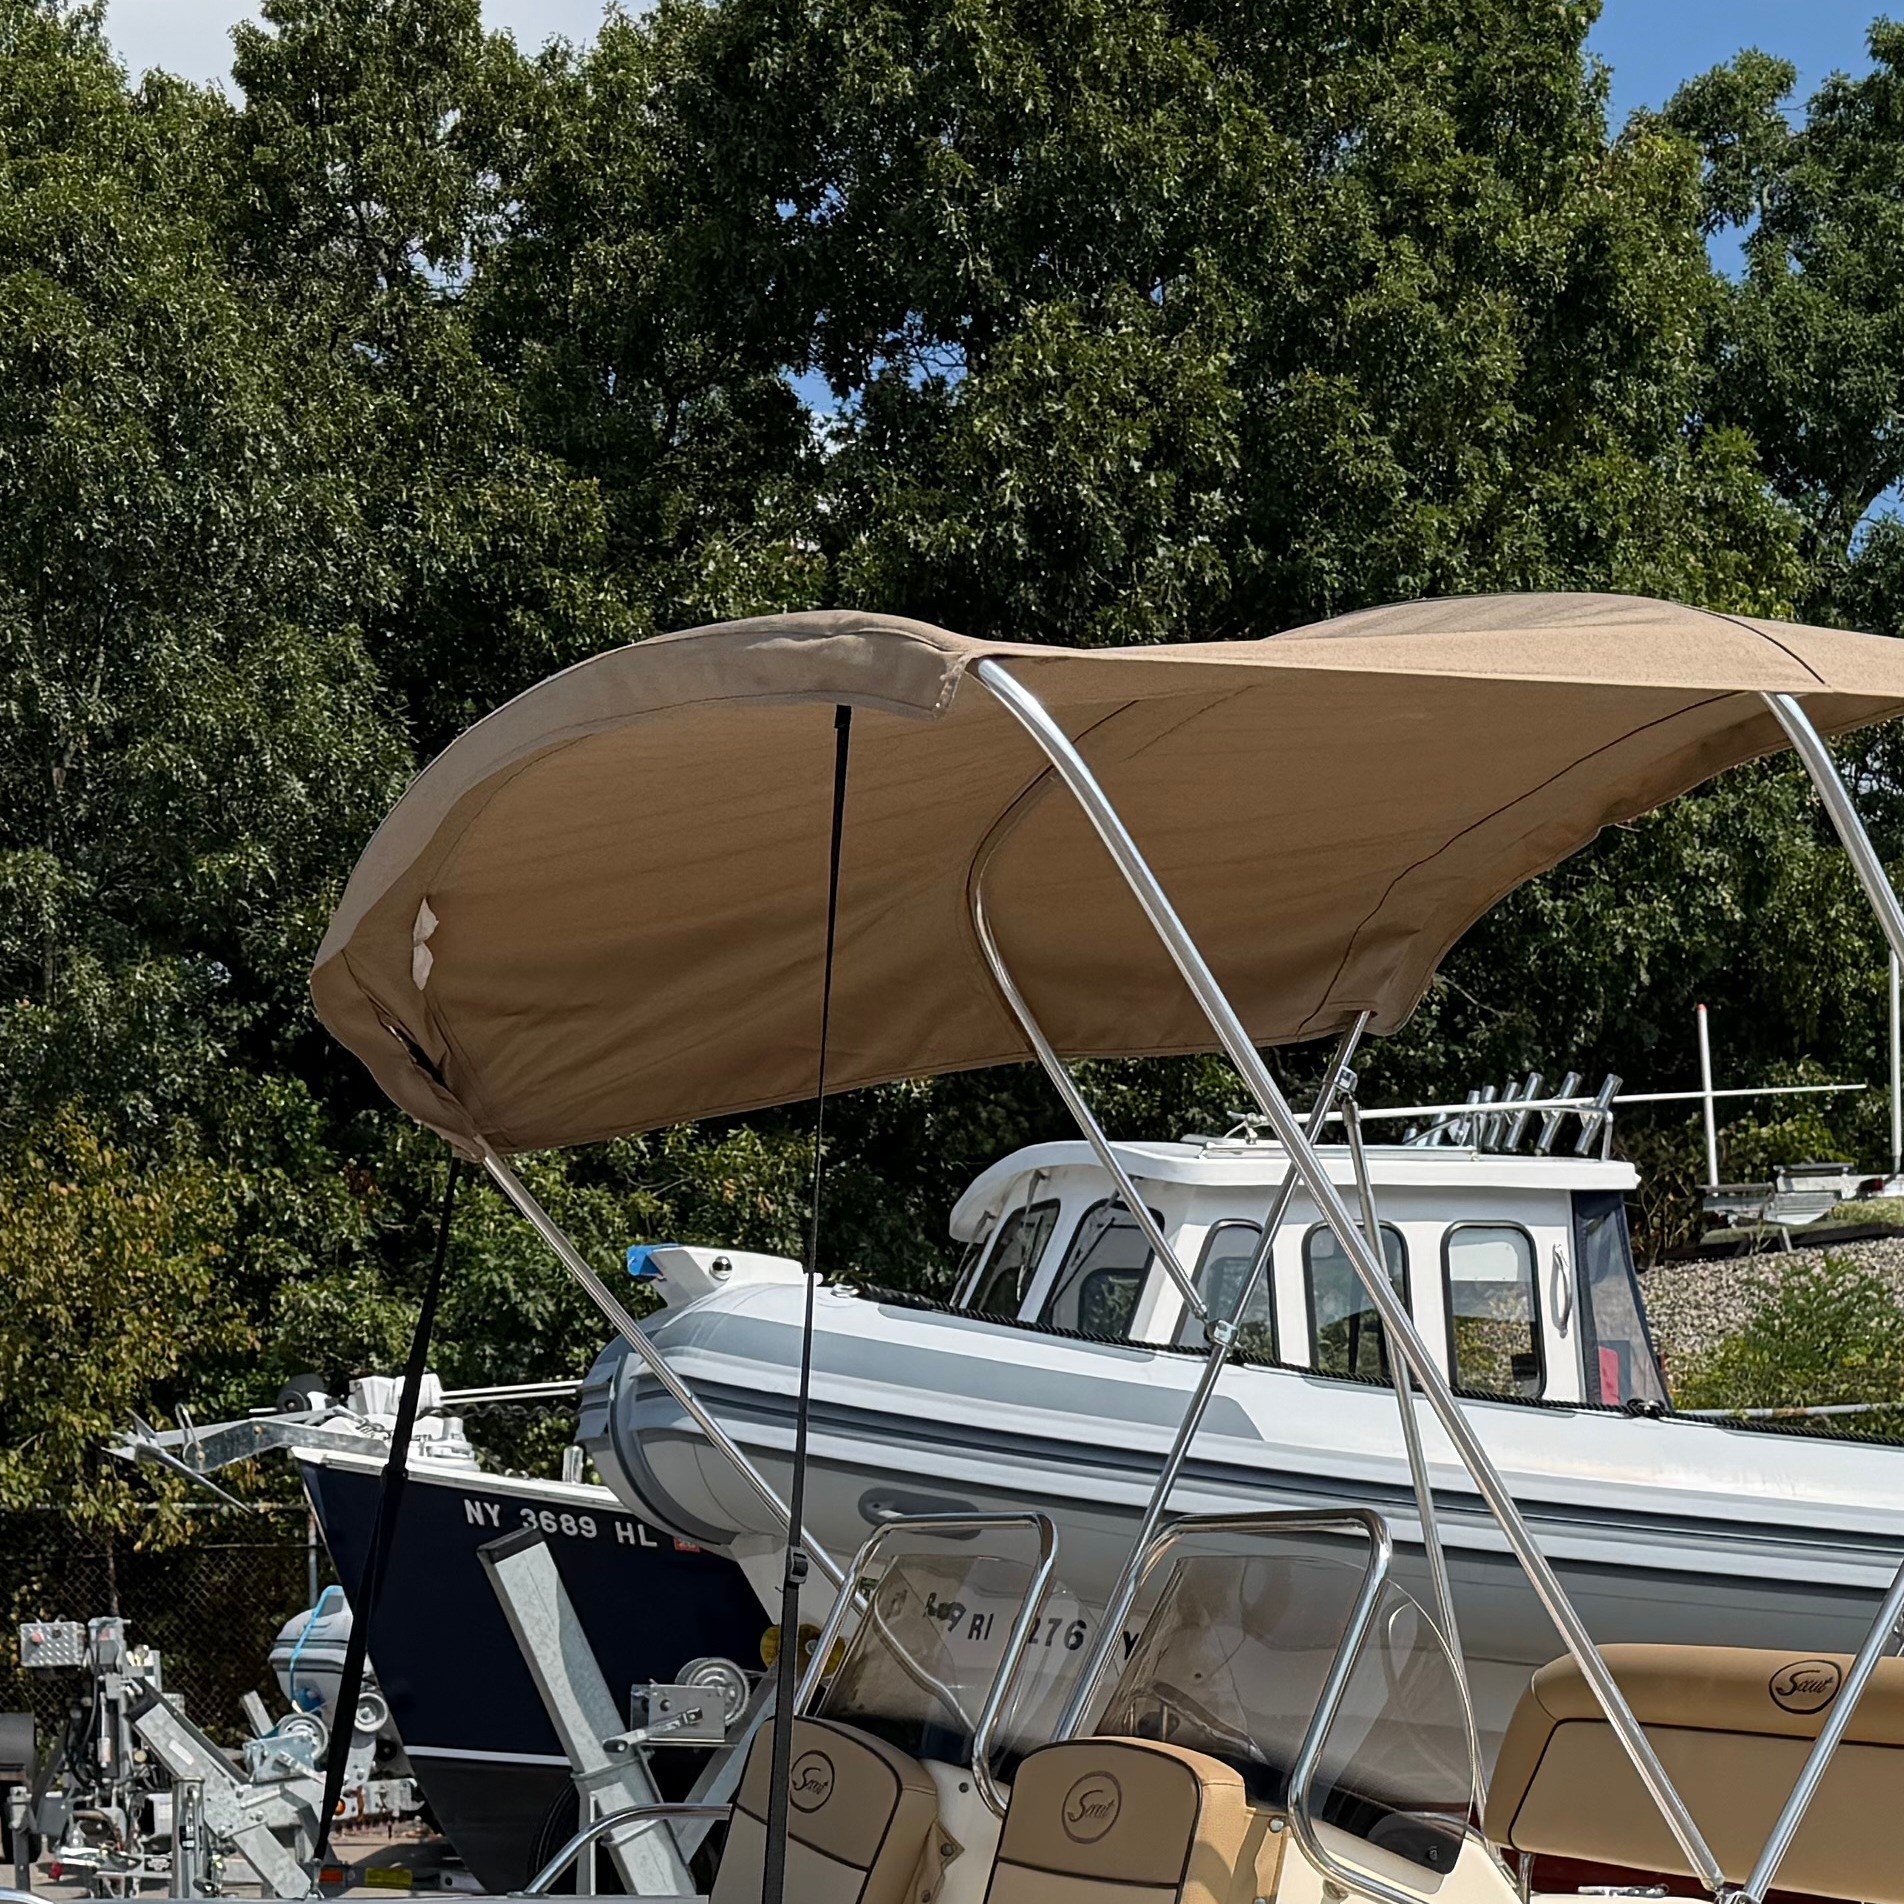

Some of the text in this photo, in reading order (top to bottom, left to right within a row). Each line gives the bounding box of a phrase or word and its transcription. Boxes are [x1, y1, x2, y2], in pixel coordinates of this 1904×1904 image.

[464, 1499, 500, 1527] NY
[519, 1508, 597, 1539] 3689
[615, 1521, 657, 1547] HL
